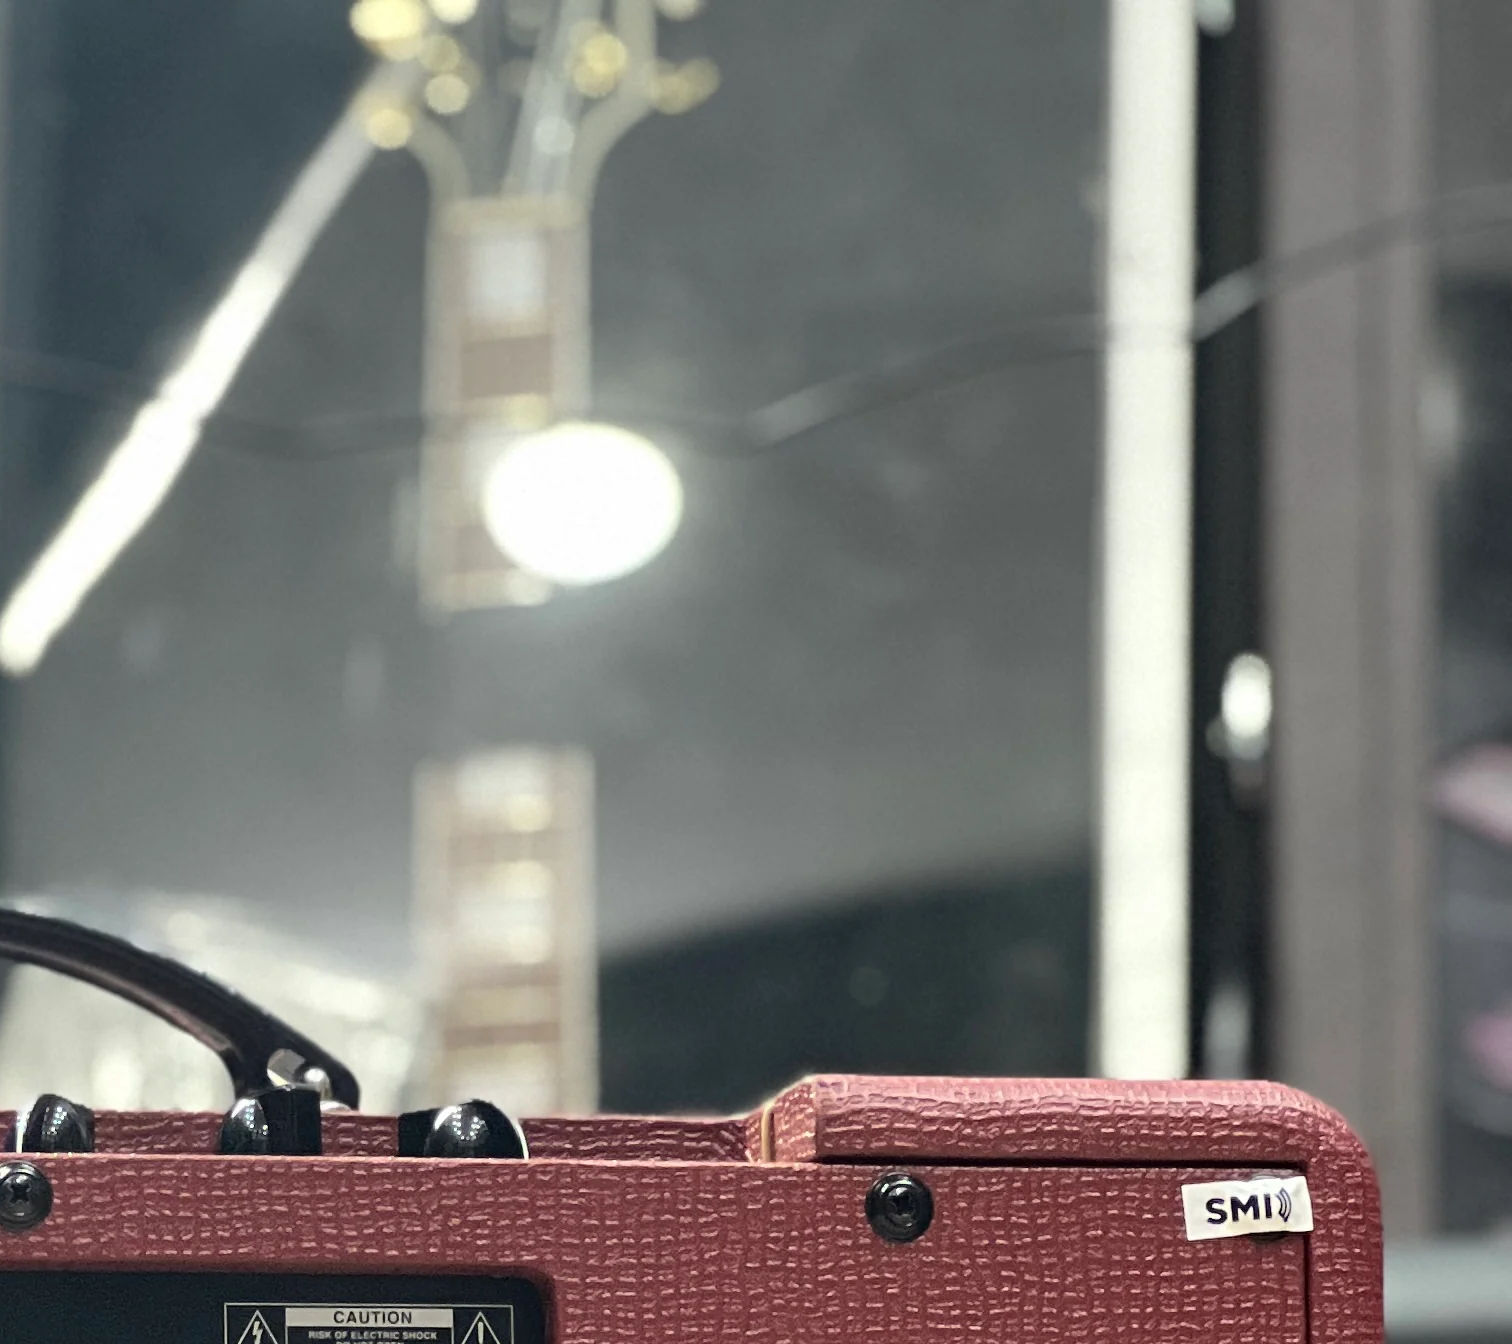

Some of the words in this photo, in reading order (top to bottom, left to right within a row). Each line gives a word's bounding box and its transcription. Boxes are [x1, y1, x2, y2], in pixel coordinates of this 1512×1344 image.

[1205, 1193, 1272, 1225] SMI
[333, 1310, 412, 1325] CAUTION
[308, 1330, 332, 1340] RISK
[334, 1330, 347, 1340] OF
[350, 1330, 400, 1341] ELECTRIC
[402, 1331, 437, 1341] SHOCK
